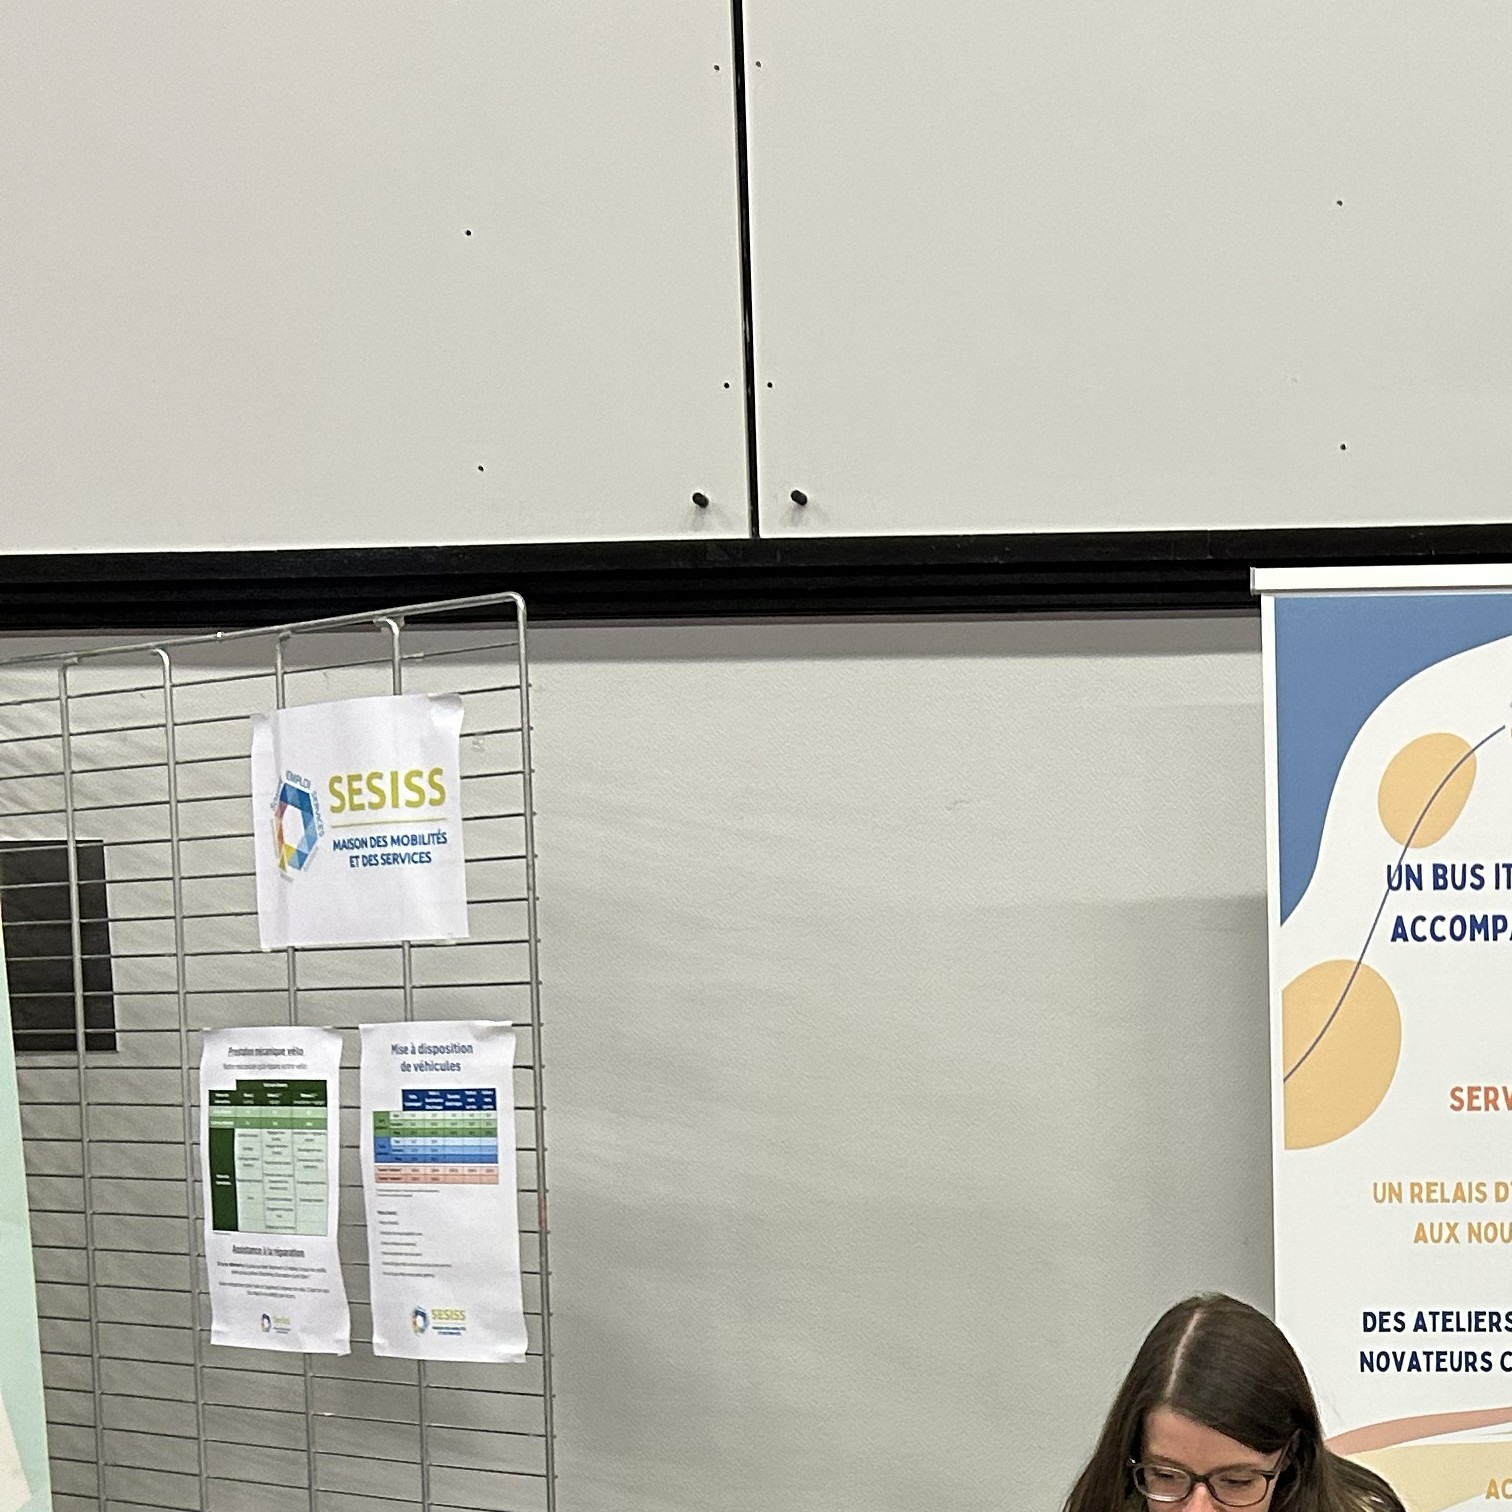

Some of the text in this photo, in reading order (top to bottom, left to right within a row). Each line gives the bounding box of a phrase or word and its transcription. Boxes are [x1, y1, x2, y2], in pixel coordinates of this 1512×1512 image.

[328, 767, 447, 814] SESISS
[333, 828, 447, 852] MAISON DES MOBILITÉS
[349, 851, 432, 868] ET DES SERVICES
[1386, 863, 1424, 891] UN
[1432, 863, 1486, 891] BUS
[410, 1042, 416, 1055] à
[418, 1042, 474, 1056] disposition
[400, 1060, 461, 1072] de véhicules
[1372, 1182, 1403, 1204] UN
[1409, 1182, 1488, 1204] RELAIS
[1413, 1222, 1462, 1245] AUX
[1362, 1311, 1405, 1333] DES
[1359, 1350, 1493, 1373] NOVATEURS
